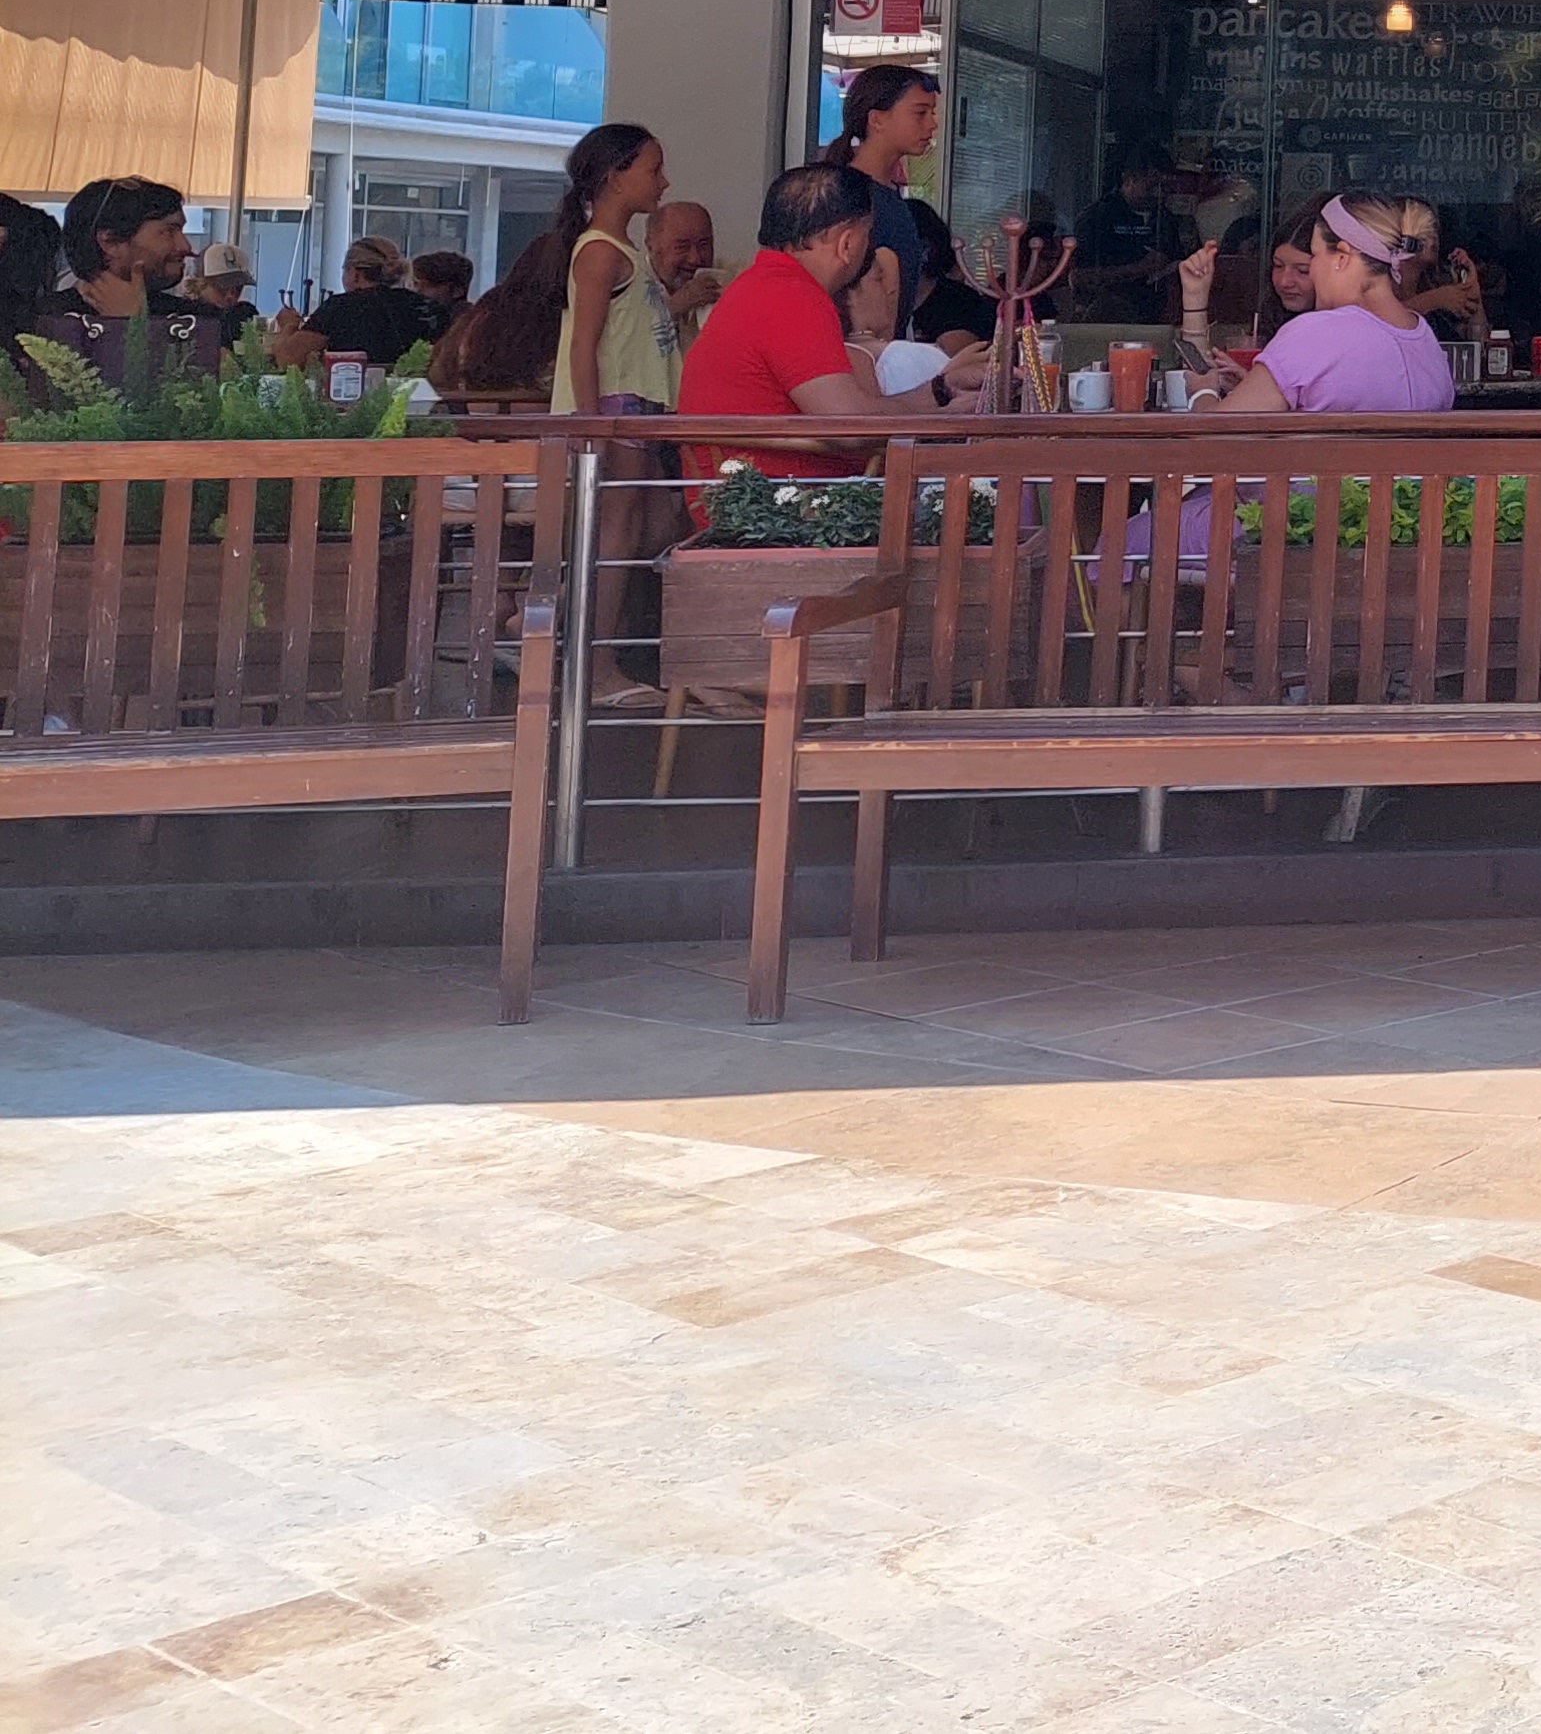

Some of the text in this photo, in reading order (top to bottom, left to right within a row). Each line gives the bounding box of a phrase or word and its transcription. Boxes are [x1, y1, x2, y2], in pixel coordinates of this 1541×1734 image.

[1332, 45, 1441, 78] waffles
[1332, 80, 1474, 104] Milkshakes
[1421, 111, 1532, 134] BUTTER
[1418, 133, 1517, 171] orange
